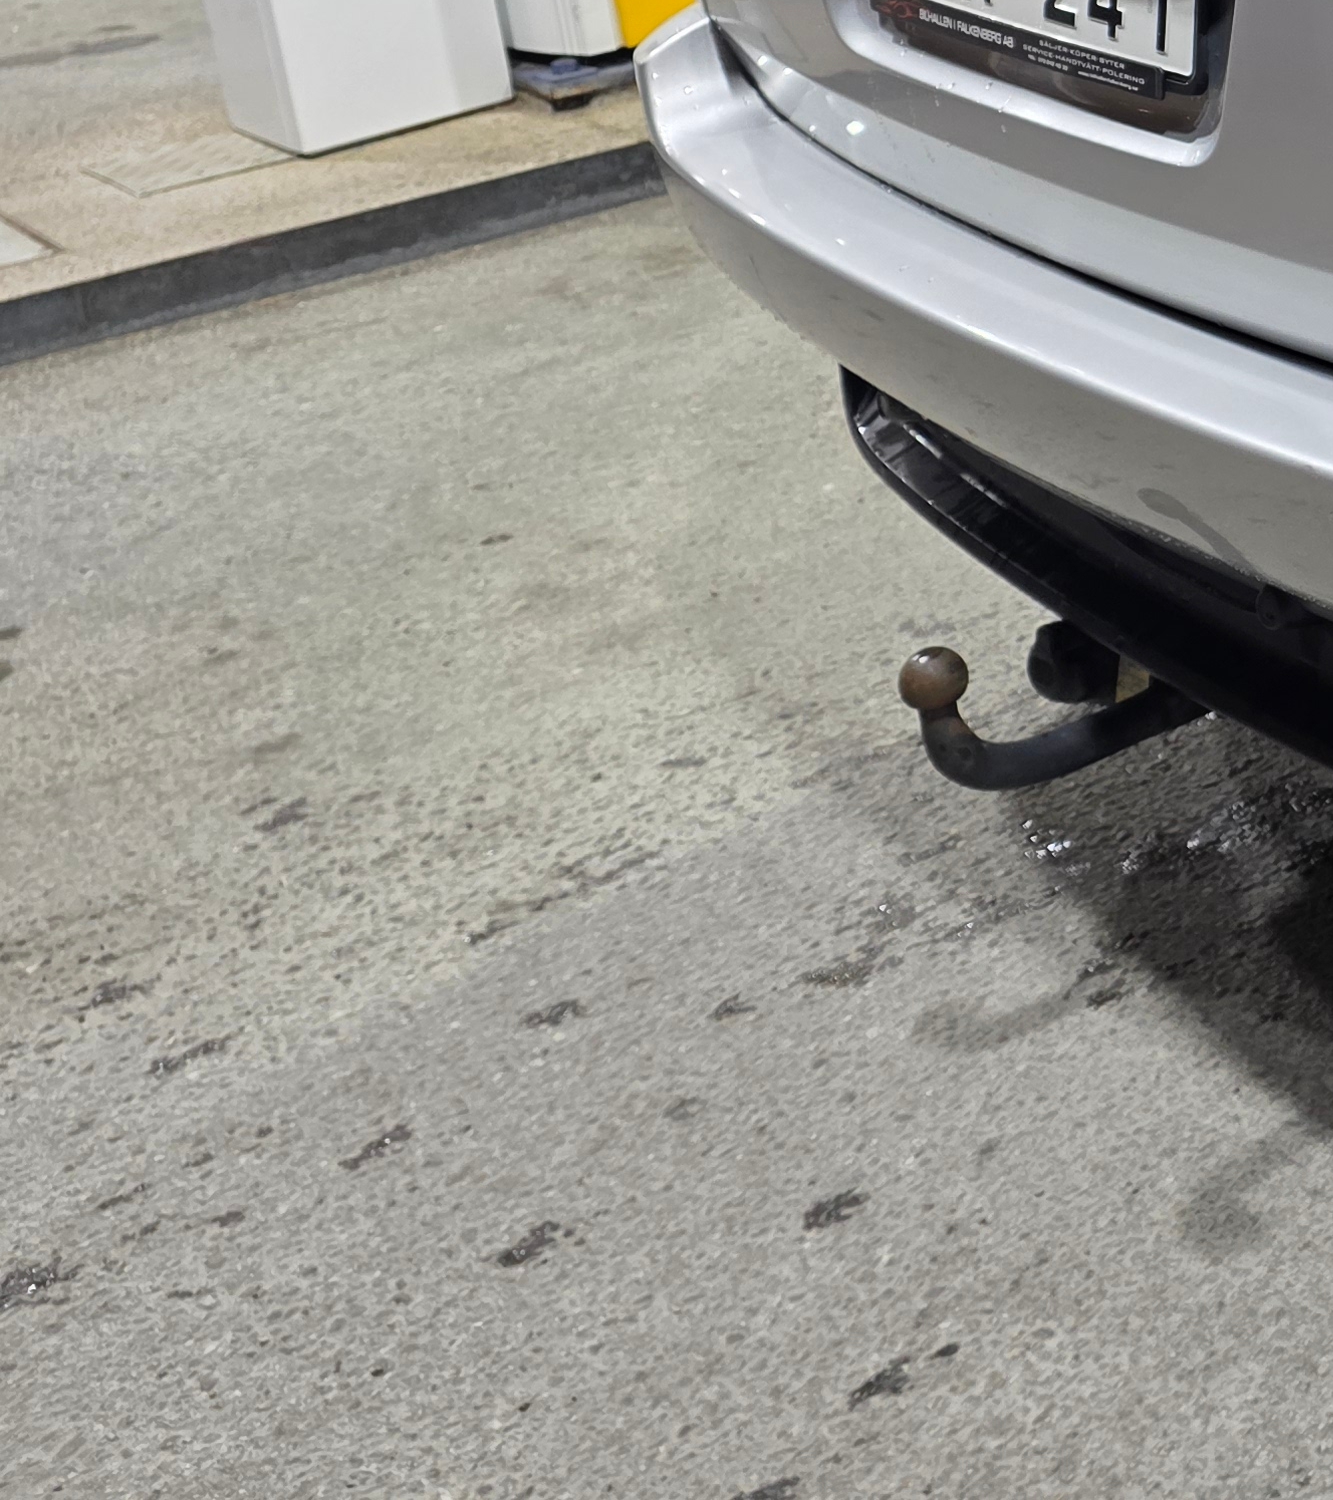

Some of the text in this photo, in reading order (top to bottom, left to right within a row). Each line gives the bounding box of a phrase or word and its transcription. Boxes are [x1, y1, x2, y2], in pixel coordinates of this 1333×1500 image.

[918, 7, 953, 30] BILHALLEN
[956, 20, 1002, 45] FALKENBERG
[1003, 35, 1015, 49] AB
